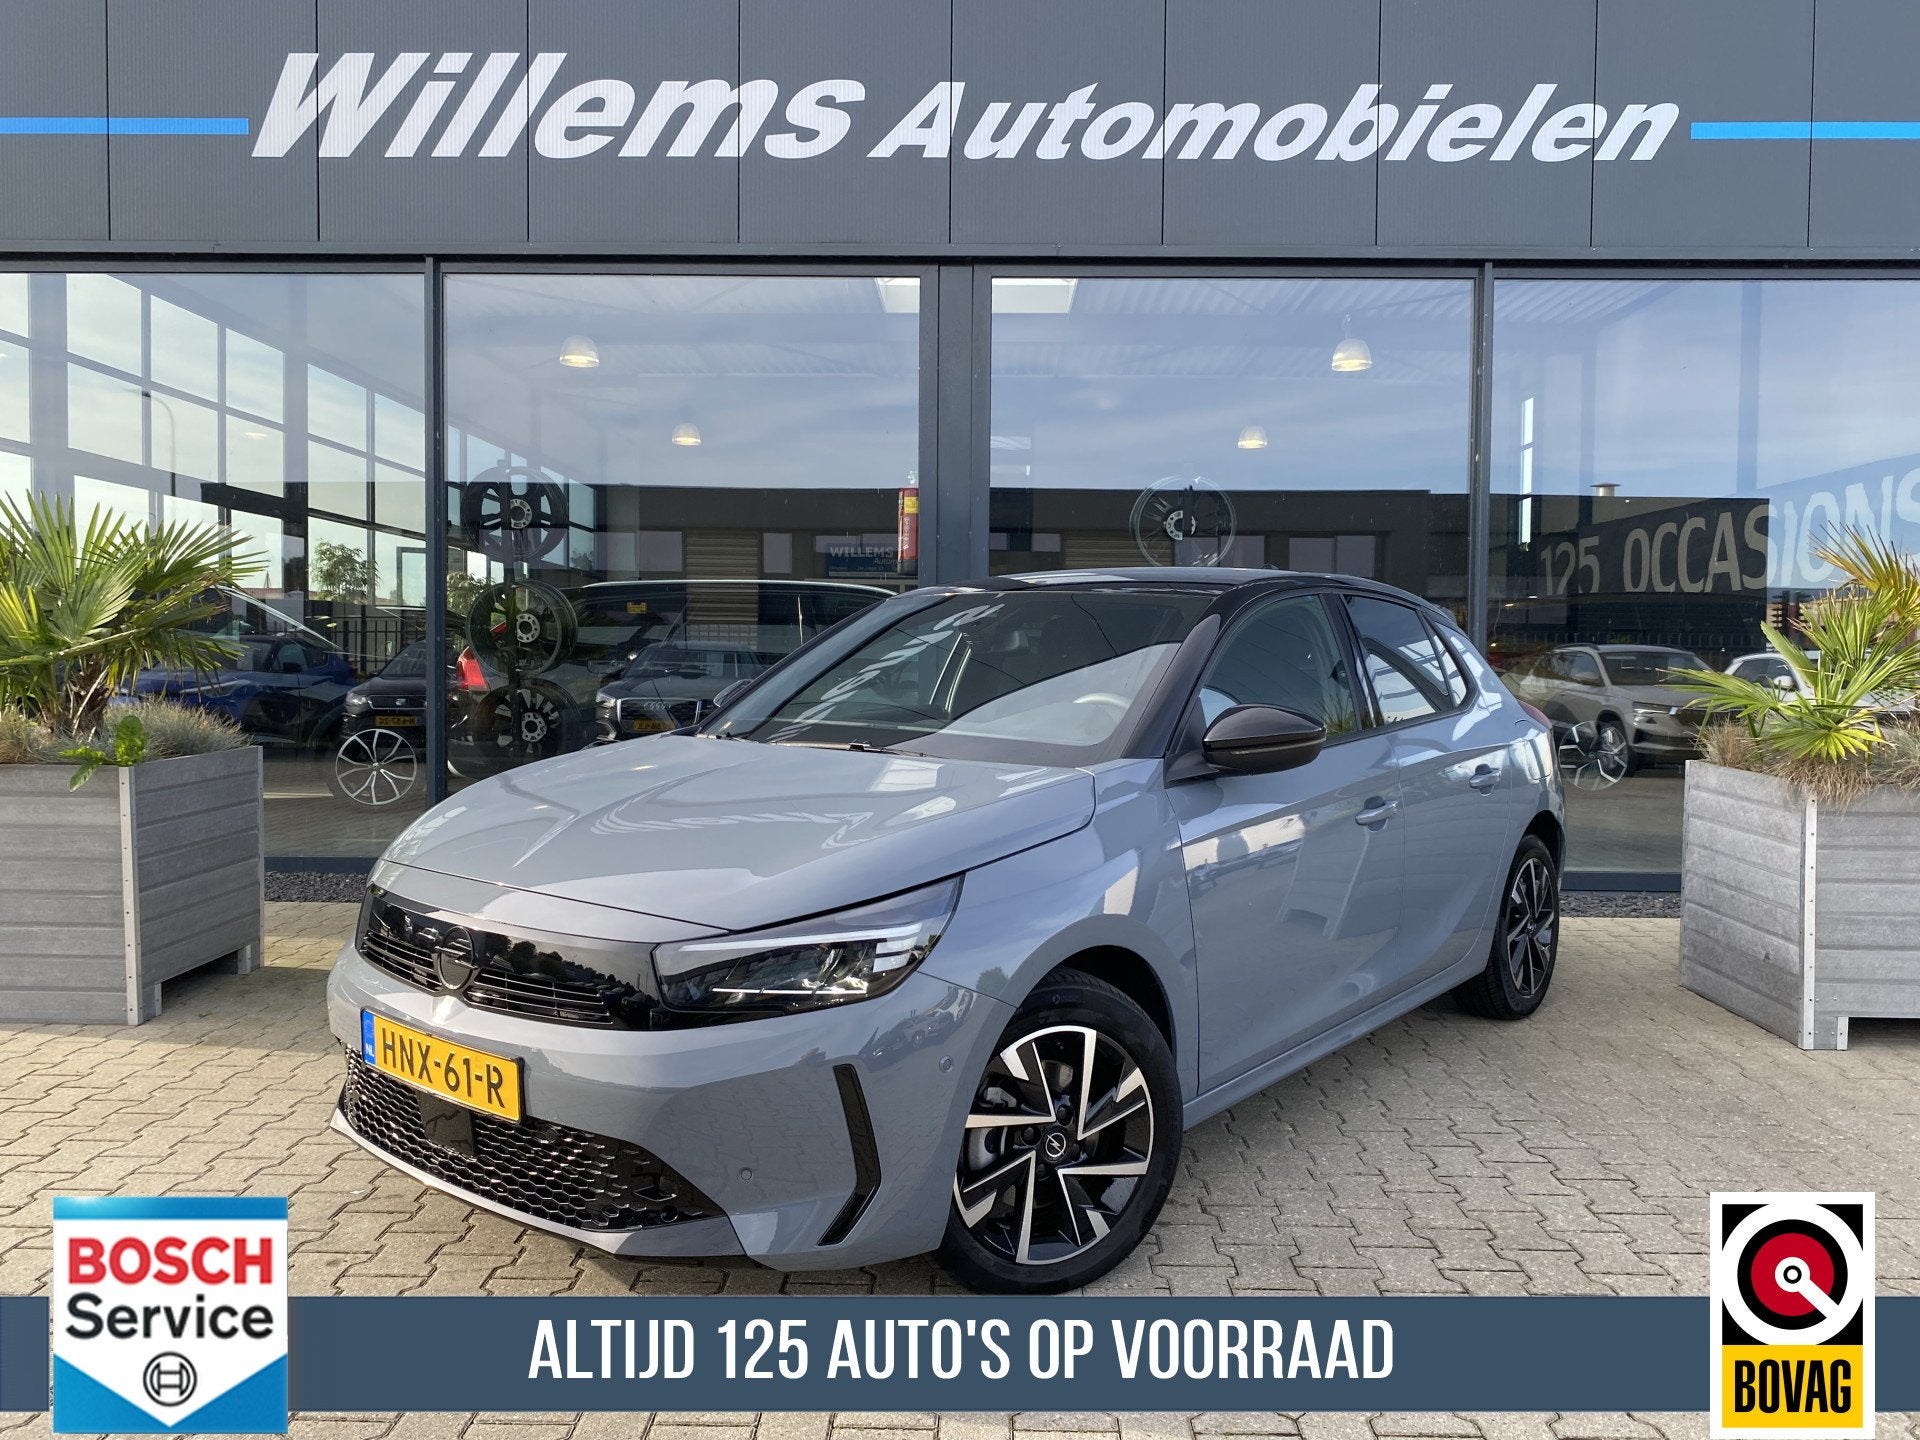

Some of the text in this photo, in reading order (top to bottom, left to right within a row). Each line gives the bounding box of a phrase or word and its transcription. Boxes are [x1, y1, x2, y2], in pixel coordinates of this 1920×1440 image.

[251, 52, 1680, 163] Willems Automobielen
[830, 546, 895, 558] WILLEMS
[1540, 535, 1600, 596] 125
[365, 1043, 375, 1058] NL
[382, 1026, 505, 1108] HNX-61-R
